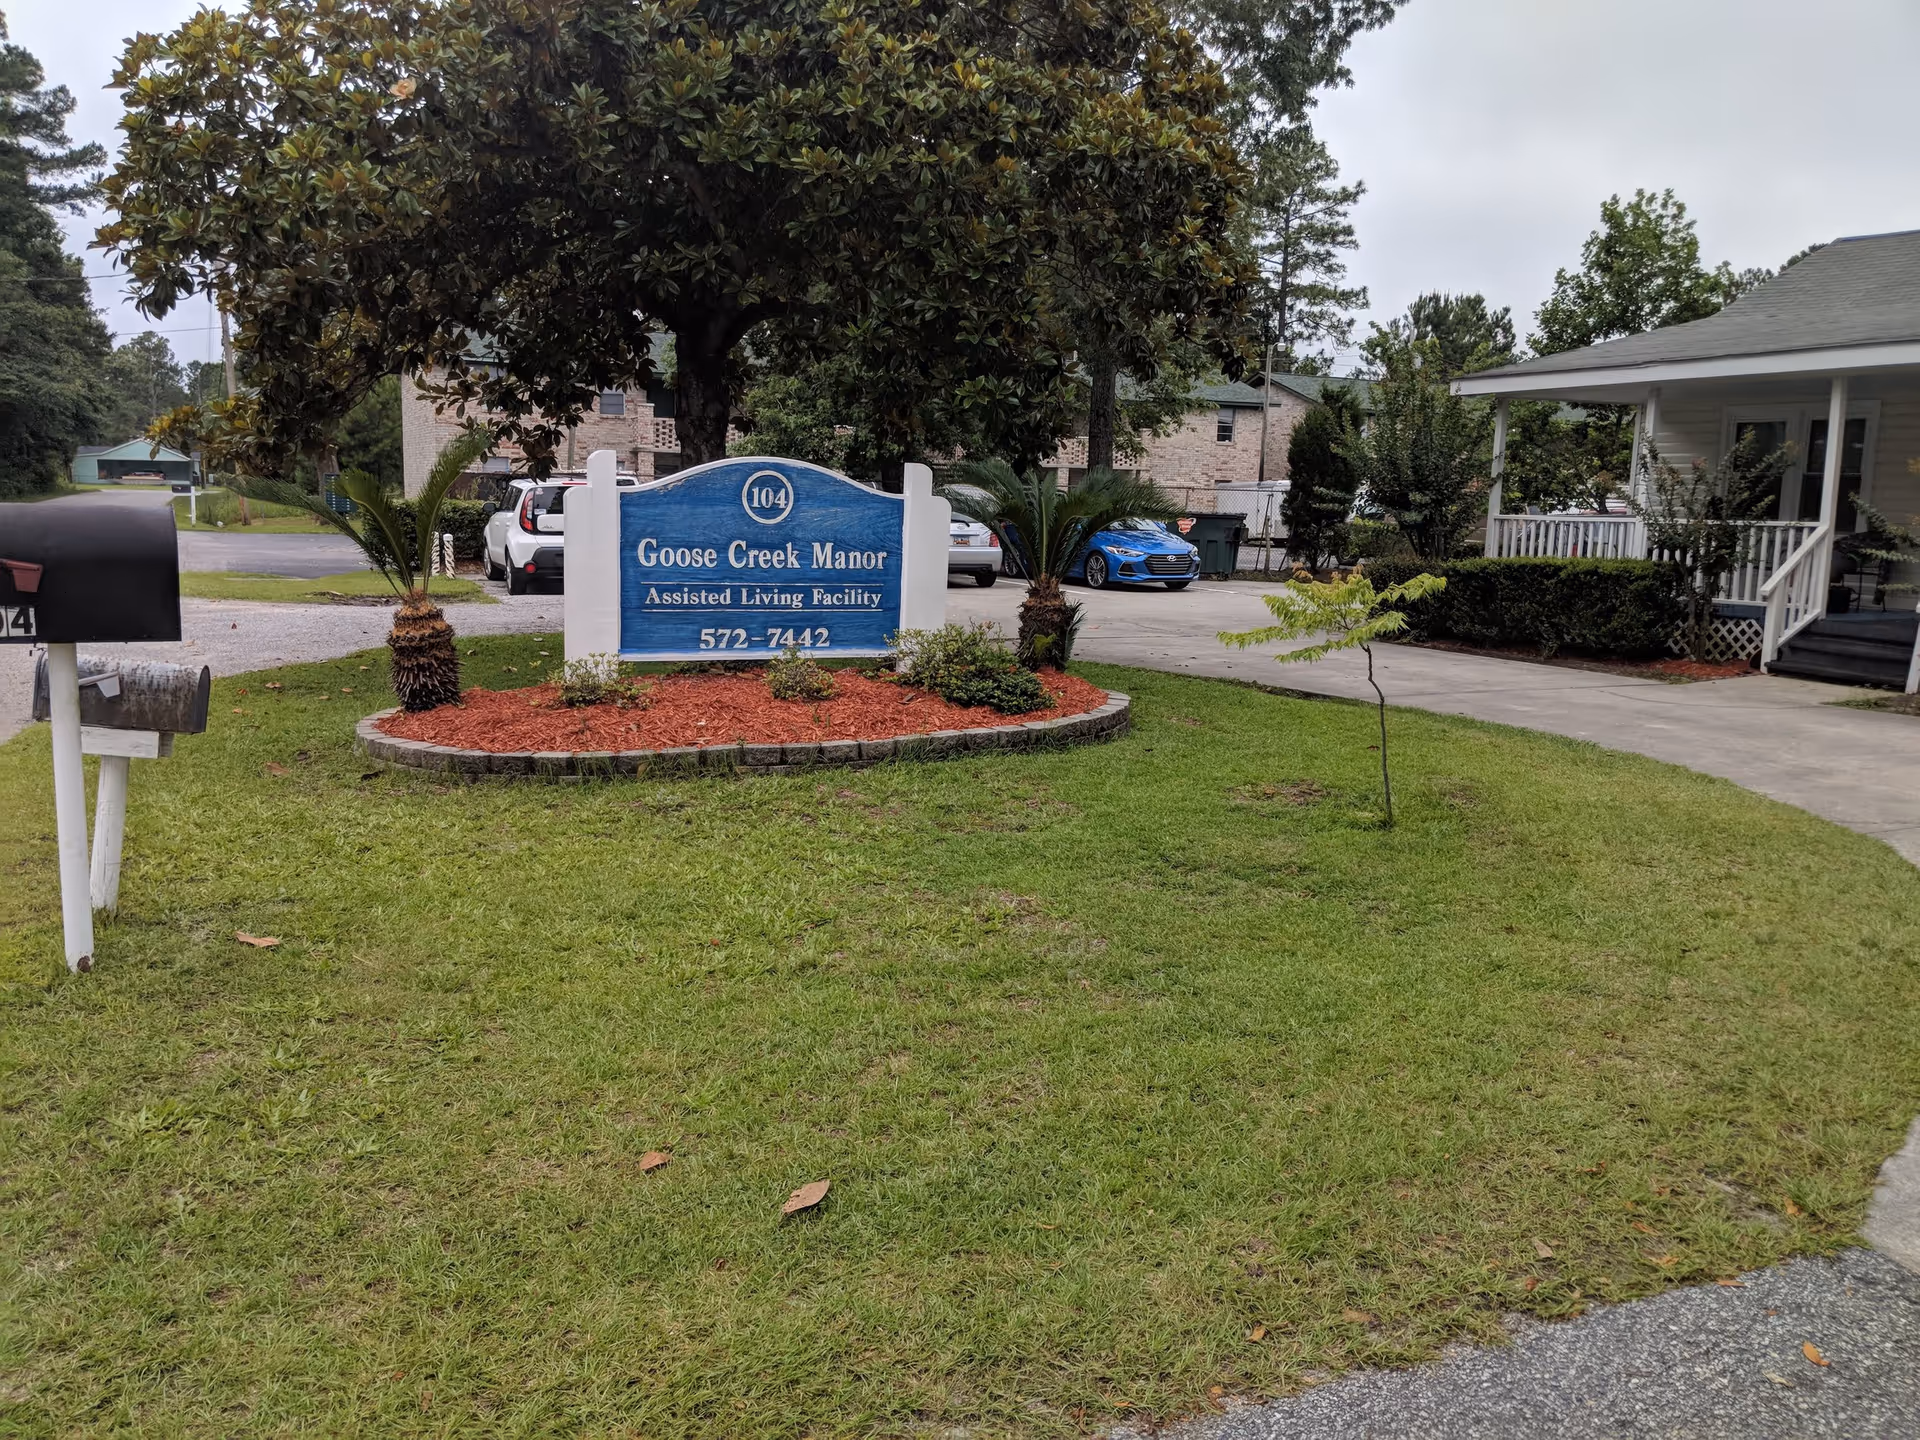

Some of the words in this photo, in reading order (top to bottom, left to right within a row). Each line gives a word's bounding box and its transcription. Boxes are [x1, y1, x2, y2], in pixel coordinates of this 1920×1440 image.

[751, 487, 787, 509] 104
[637, 537, 718, 568] Goose
[728, 539, 801, 569] Creek
[811, 542, 887, 570] Manor
[645, 587, 731, 605] Assisted
[741, 588, 804, 608] Living
[812, 588, 882, 608] Facility
[0, 607, 33, 635] 4
[700, 627, 830, 648] 572-7442
